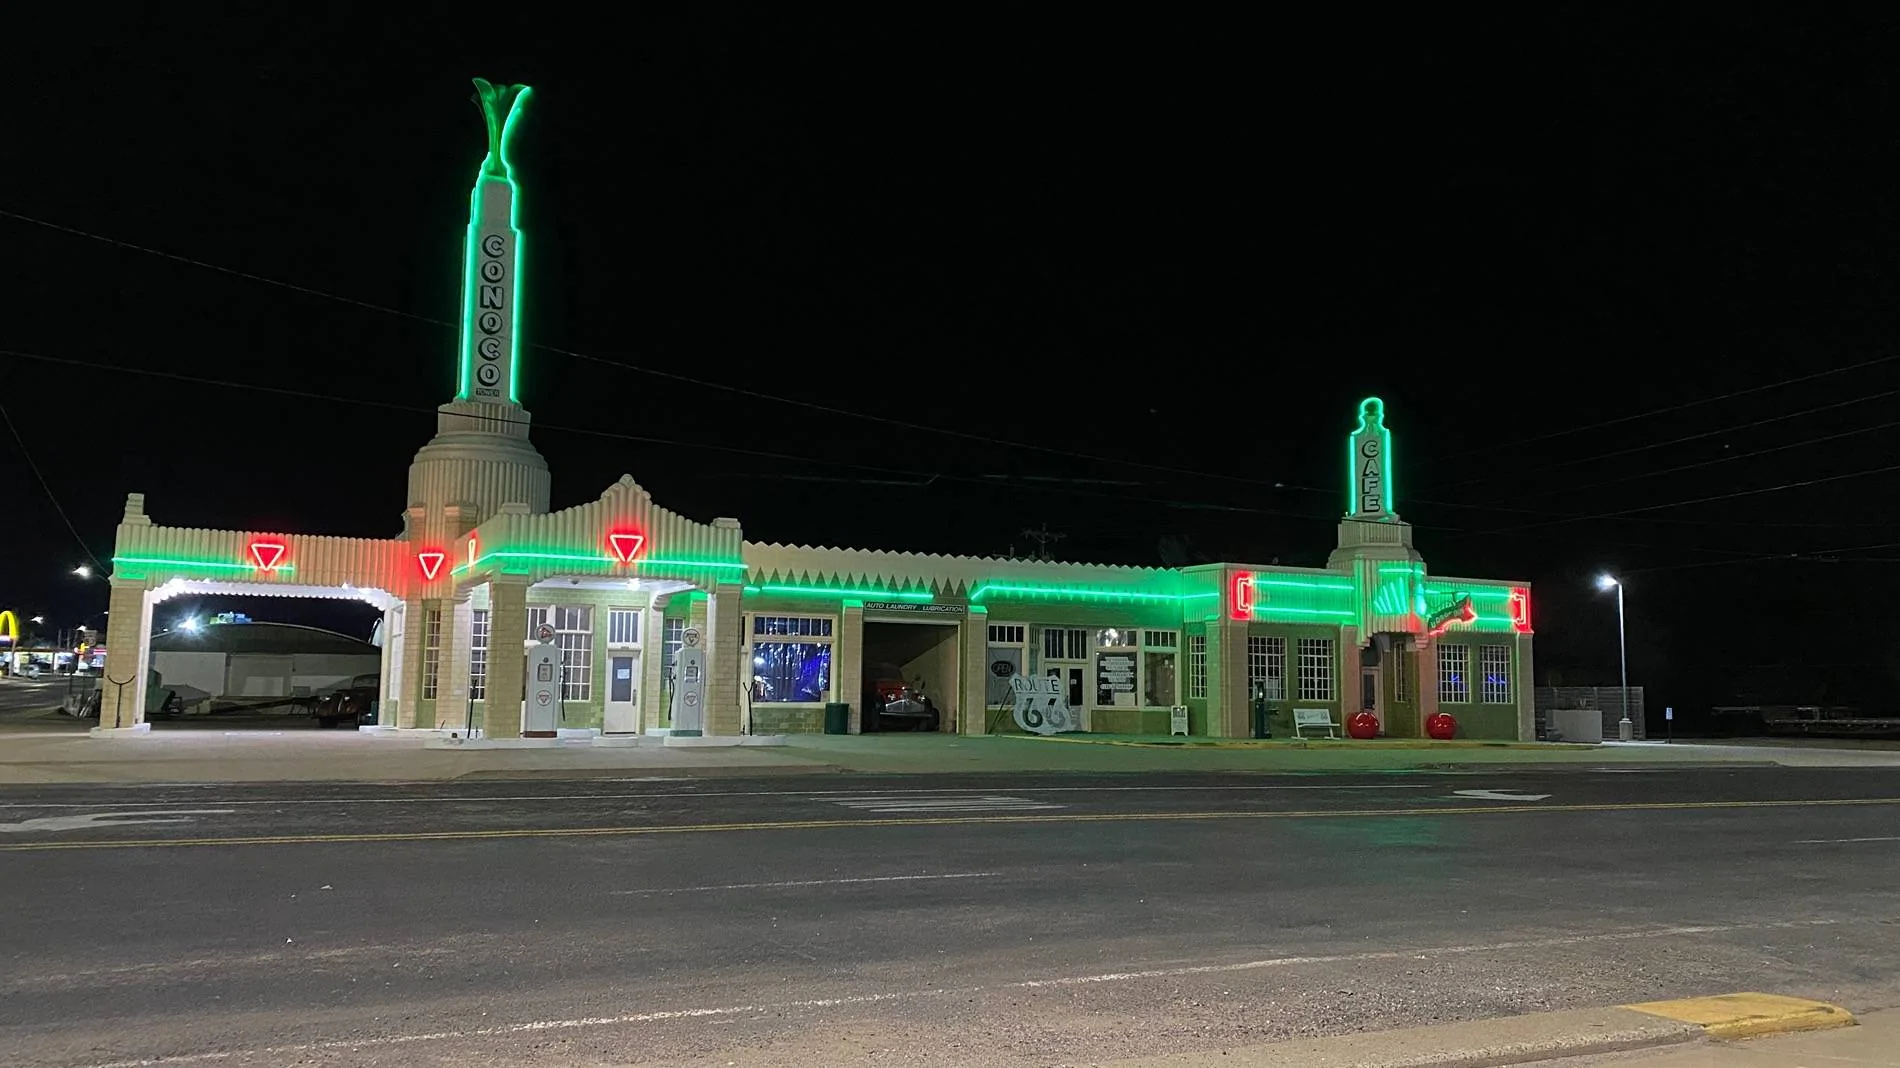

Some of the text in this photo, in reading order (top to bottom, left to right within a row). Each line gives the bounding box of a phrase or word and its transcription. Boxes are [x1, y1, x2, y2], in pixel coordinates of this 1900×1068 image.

[477, 234, 505, 387] CONOCO
[1361, 440, 1380, 513] CAFE
[886, 602, 917, 610] LAUNDRY
[922, 604, 963, 612] LUBRICATION
[1014, 678, 1060, 692] ROUTE
[1022, 697, 1066, 729] 66
